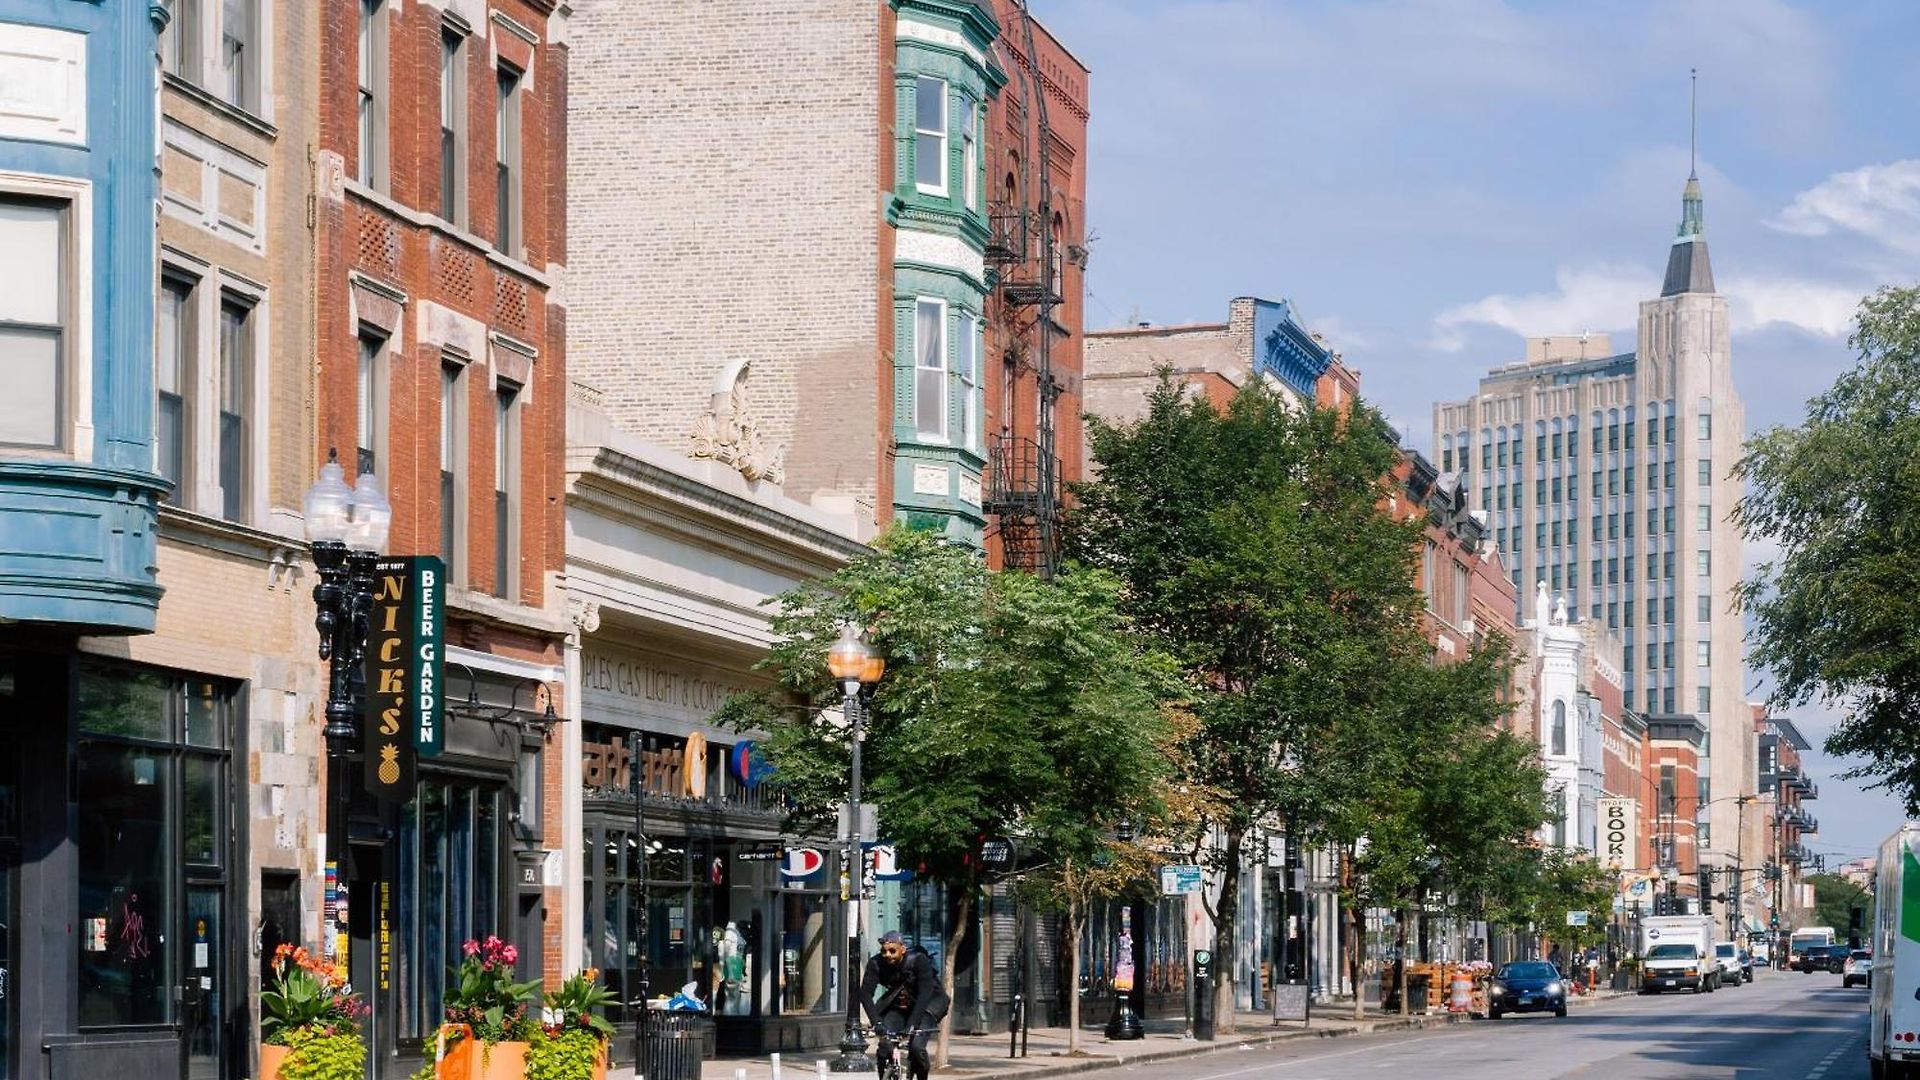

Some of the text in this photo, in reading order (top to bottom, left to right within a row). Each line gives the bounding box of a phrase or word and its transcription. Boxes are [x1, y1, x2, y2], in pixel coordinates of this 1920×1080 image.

[374, 575, 406, 735] NICK'S
[420, 570, 435, 742] BEER GARDEN
[617, 662, 641, 697] GAS
[645, 664, 679, 705] LIGHT
[1608, 806, 1625, 866] BOOK
